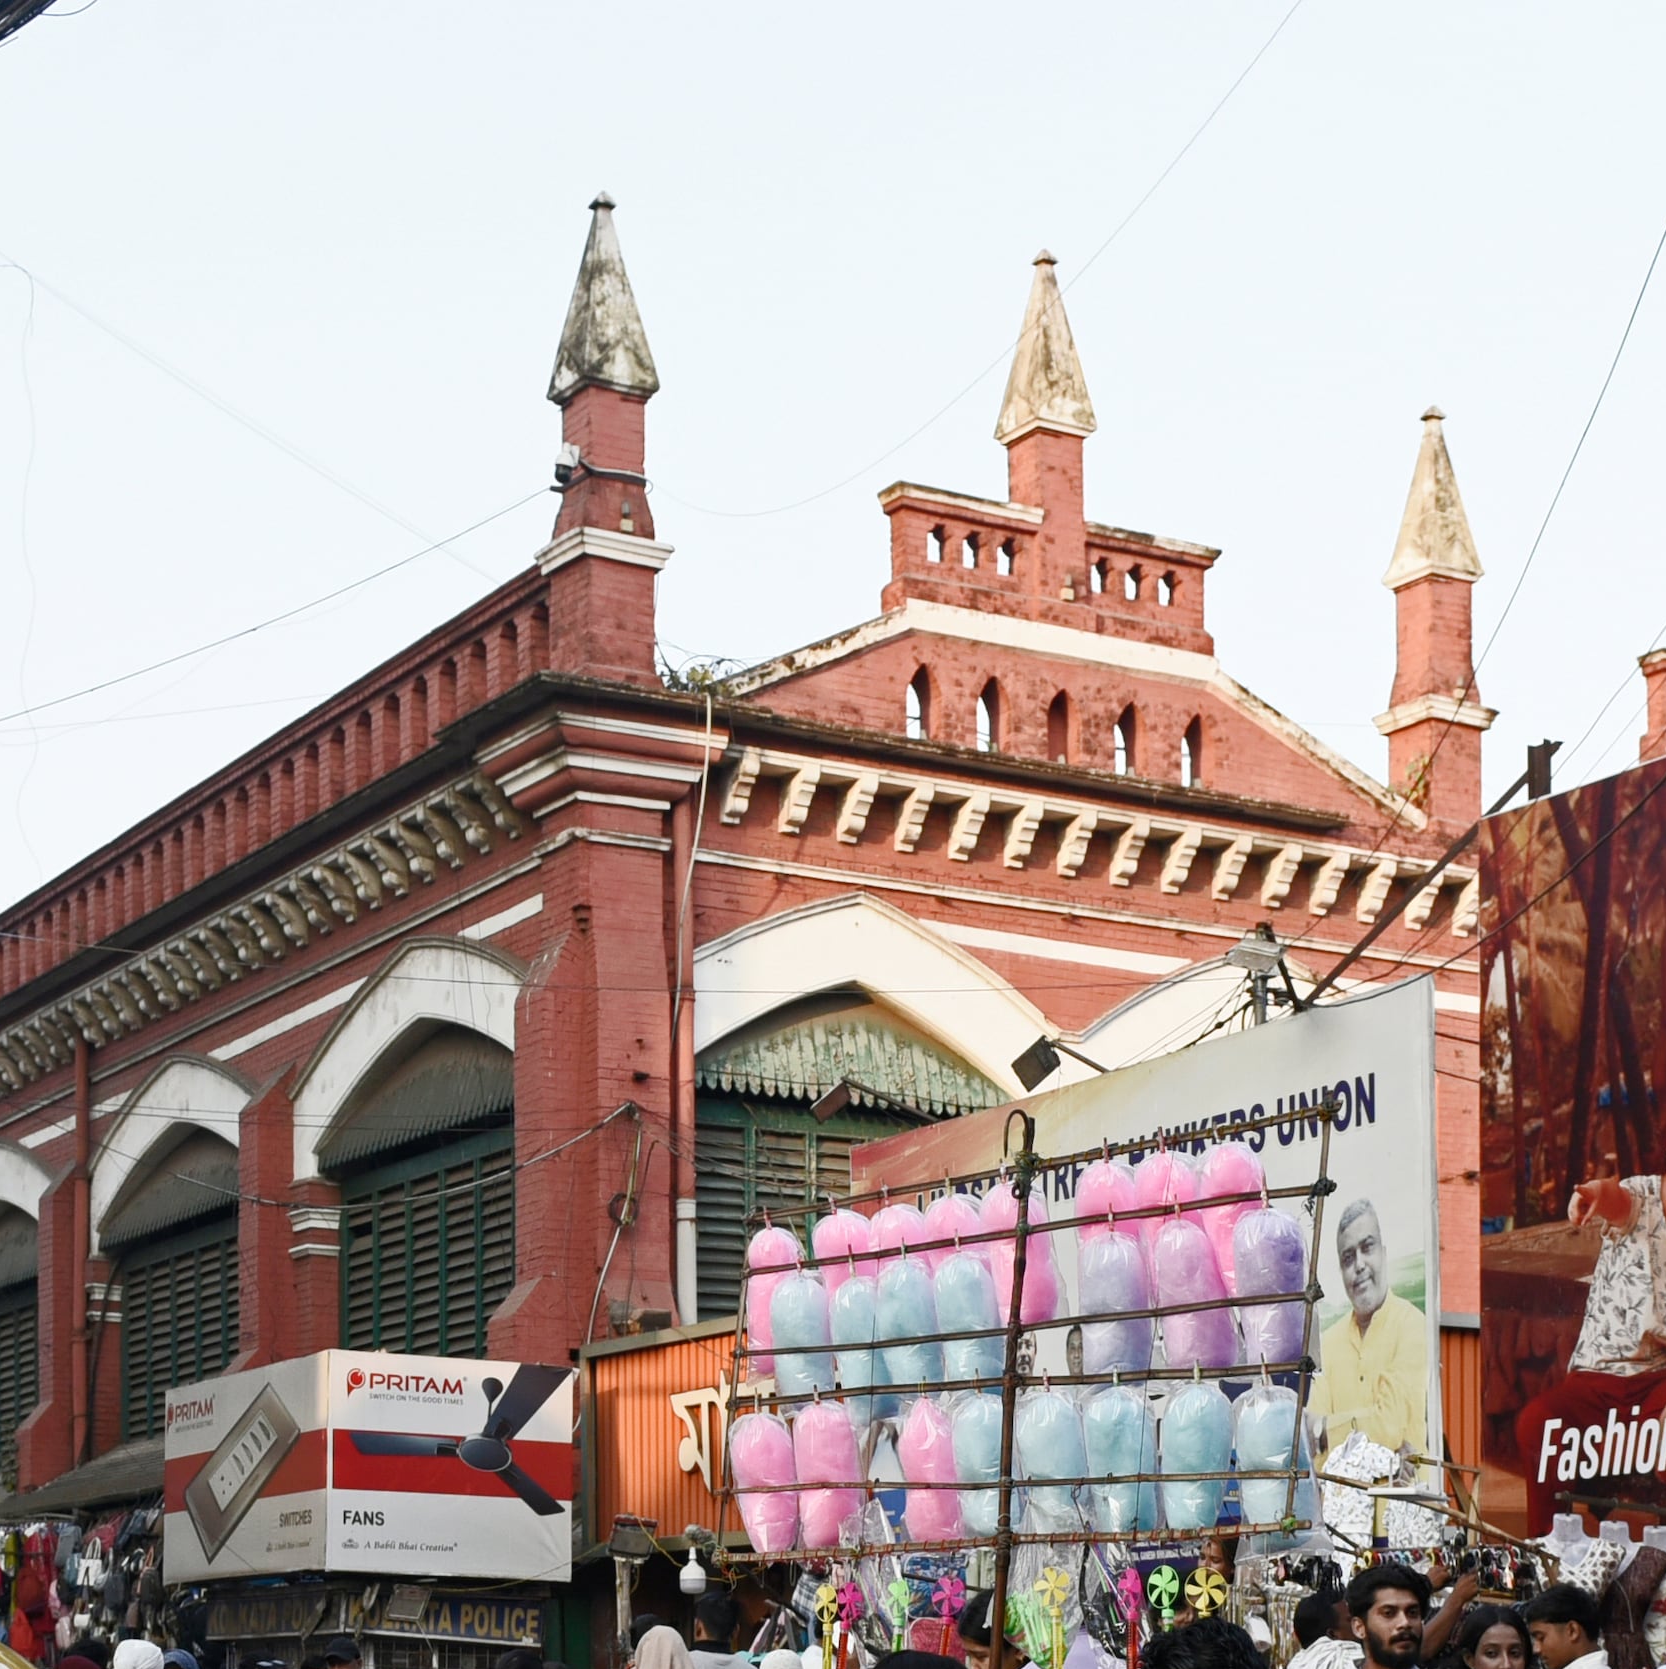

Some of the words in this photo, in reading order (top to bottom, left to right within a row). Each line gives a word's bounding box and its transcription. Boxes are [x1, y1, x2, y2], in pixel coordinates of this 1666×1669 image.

[369, 1372, 463, 1395] PRITAM
[369, 1393, 394, 1401] SWITCH
[422, 1396, 442, 1404] GOOD
[444, 1397, 463, 1405] TIMES
[279, 1509, 312, 1527] SWITCHES
[342, 1509, 385, 1526] FANS
[460, 1603, 540, 1641] POLICE
